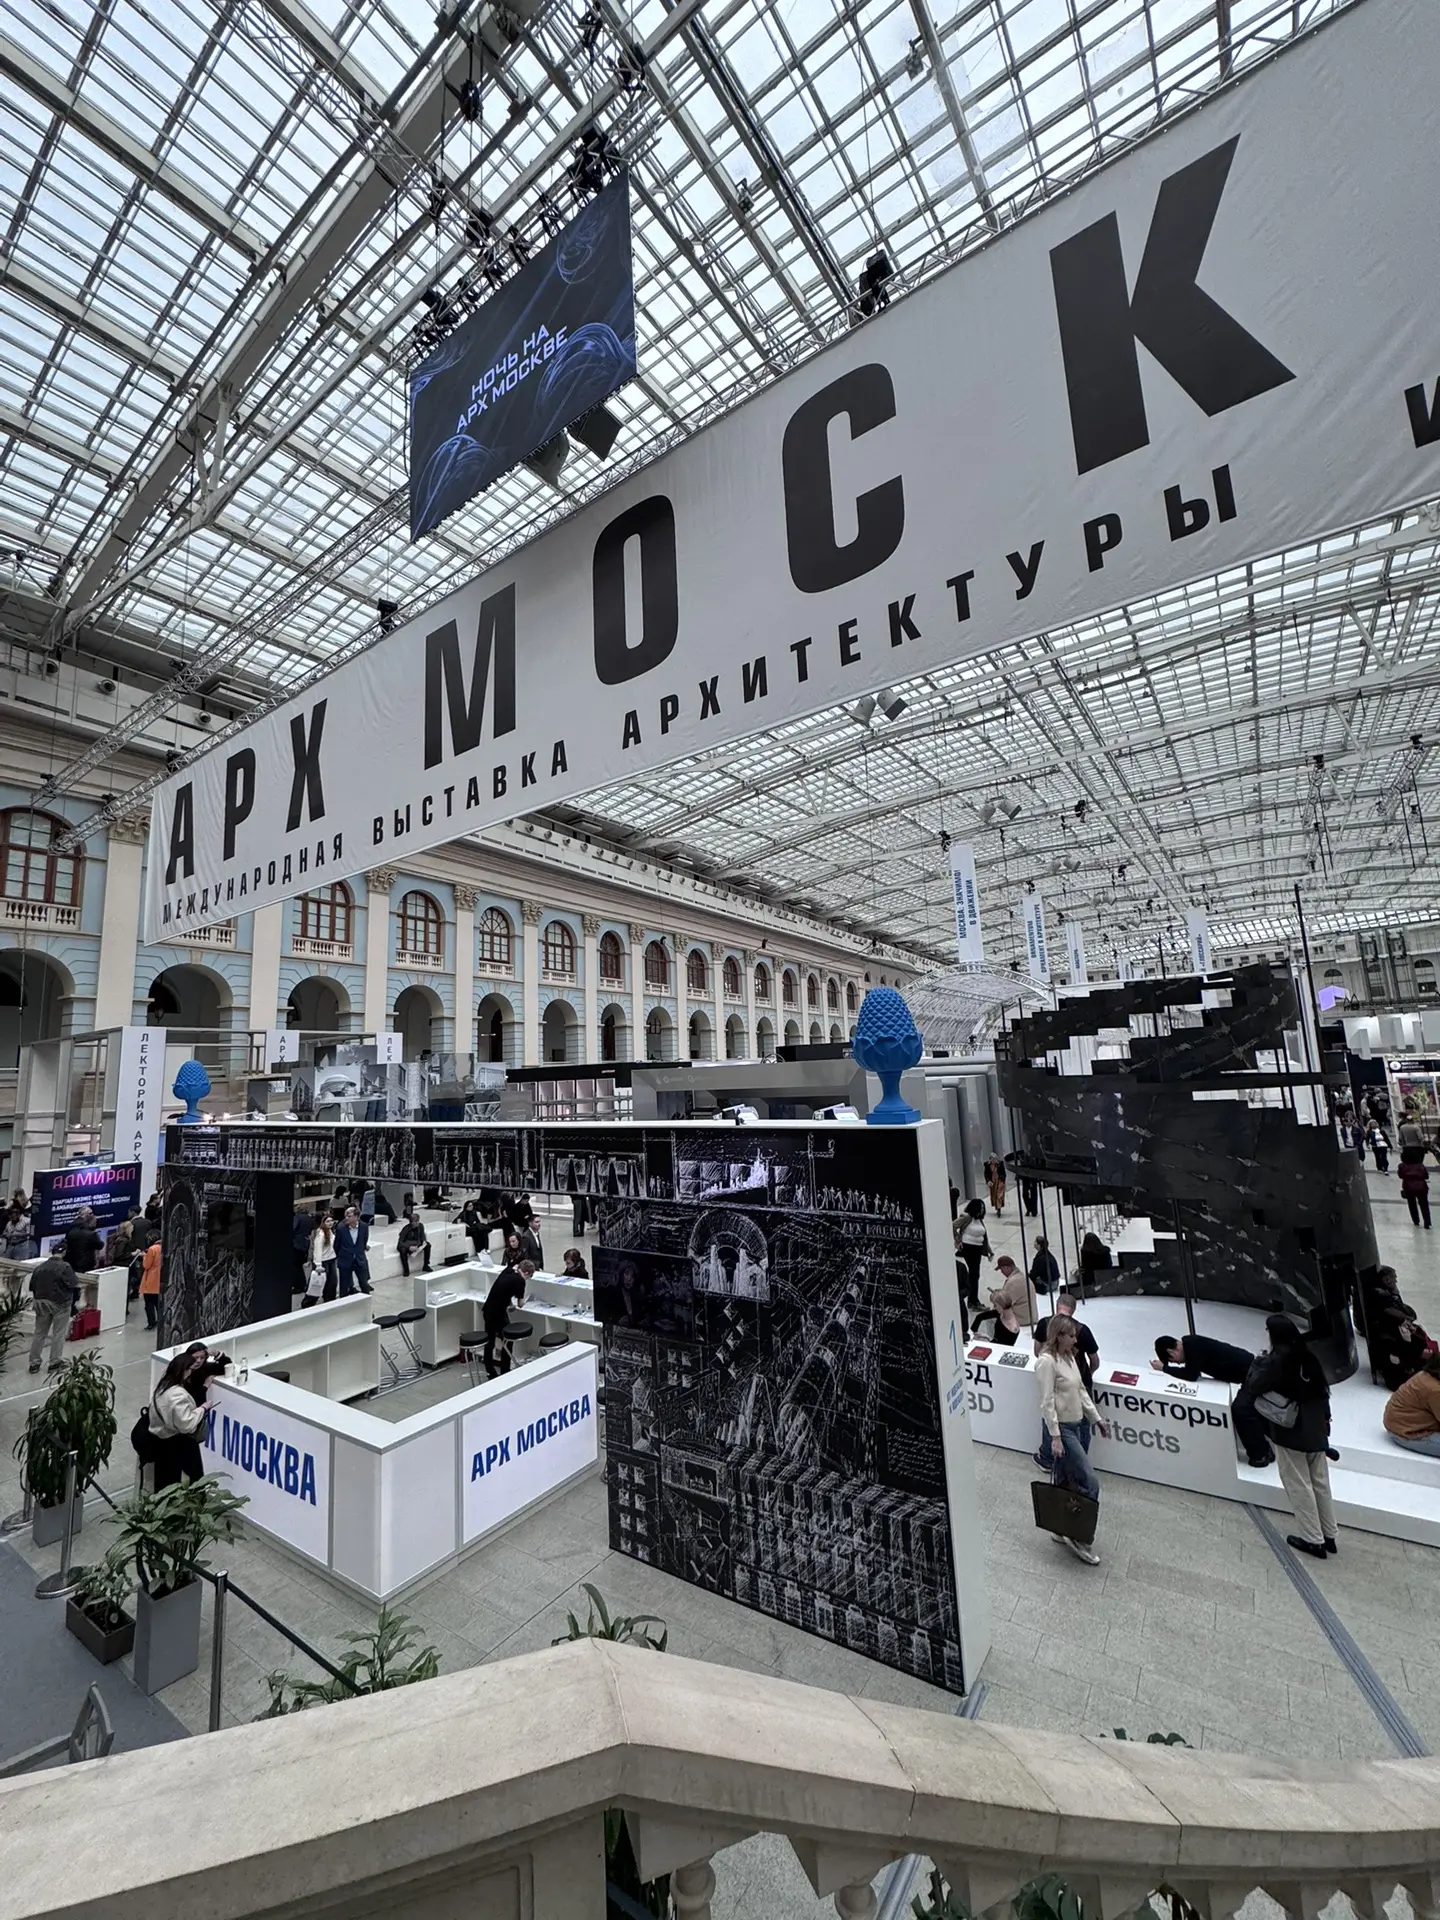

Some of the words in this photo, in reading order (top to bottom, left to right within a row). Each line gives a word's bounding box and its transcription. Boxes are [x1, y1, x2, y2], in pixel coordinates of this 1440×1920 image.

[456, 394, 488, 433] АРХ
[492, 326, 569, 403] МОСКВЕ
[471, 352, 519, 401] НОЧЬ
[523, 324, 549, 356] НА
[162, 831, 343, 925] МЕЖДУНАРОДНАЯ
[373, 739, 568, 846] ВЫСТАВКА
[622, 463, 1238, 750] АРХИТЕКТУРЫ
[165, 696, 328, 886] АРХ
[957, 907, 967, 938] МОСКВА:
[135, 1033, 149, 1121] ЛЕКТОРИЙ
[53, 1168, 136, 1189] АДМИРАЛ
[133, 1130, 143, 1162] АРХ
[222, 1414, 317, 1507] МОСКВА
[471, 1436, 511, 1483] АРХ
[517, 1393, 592, 1456] МОСКВА
